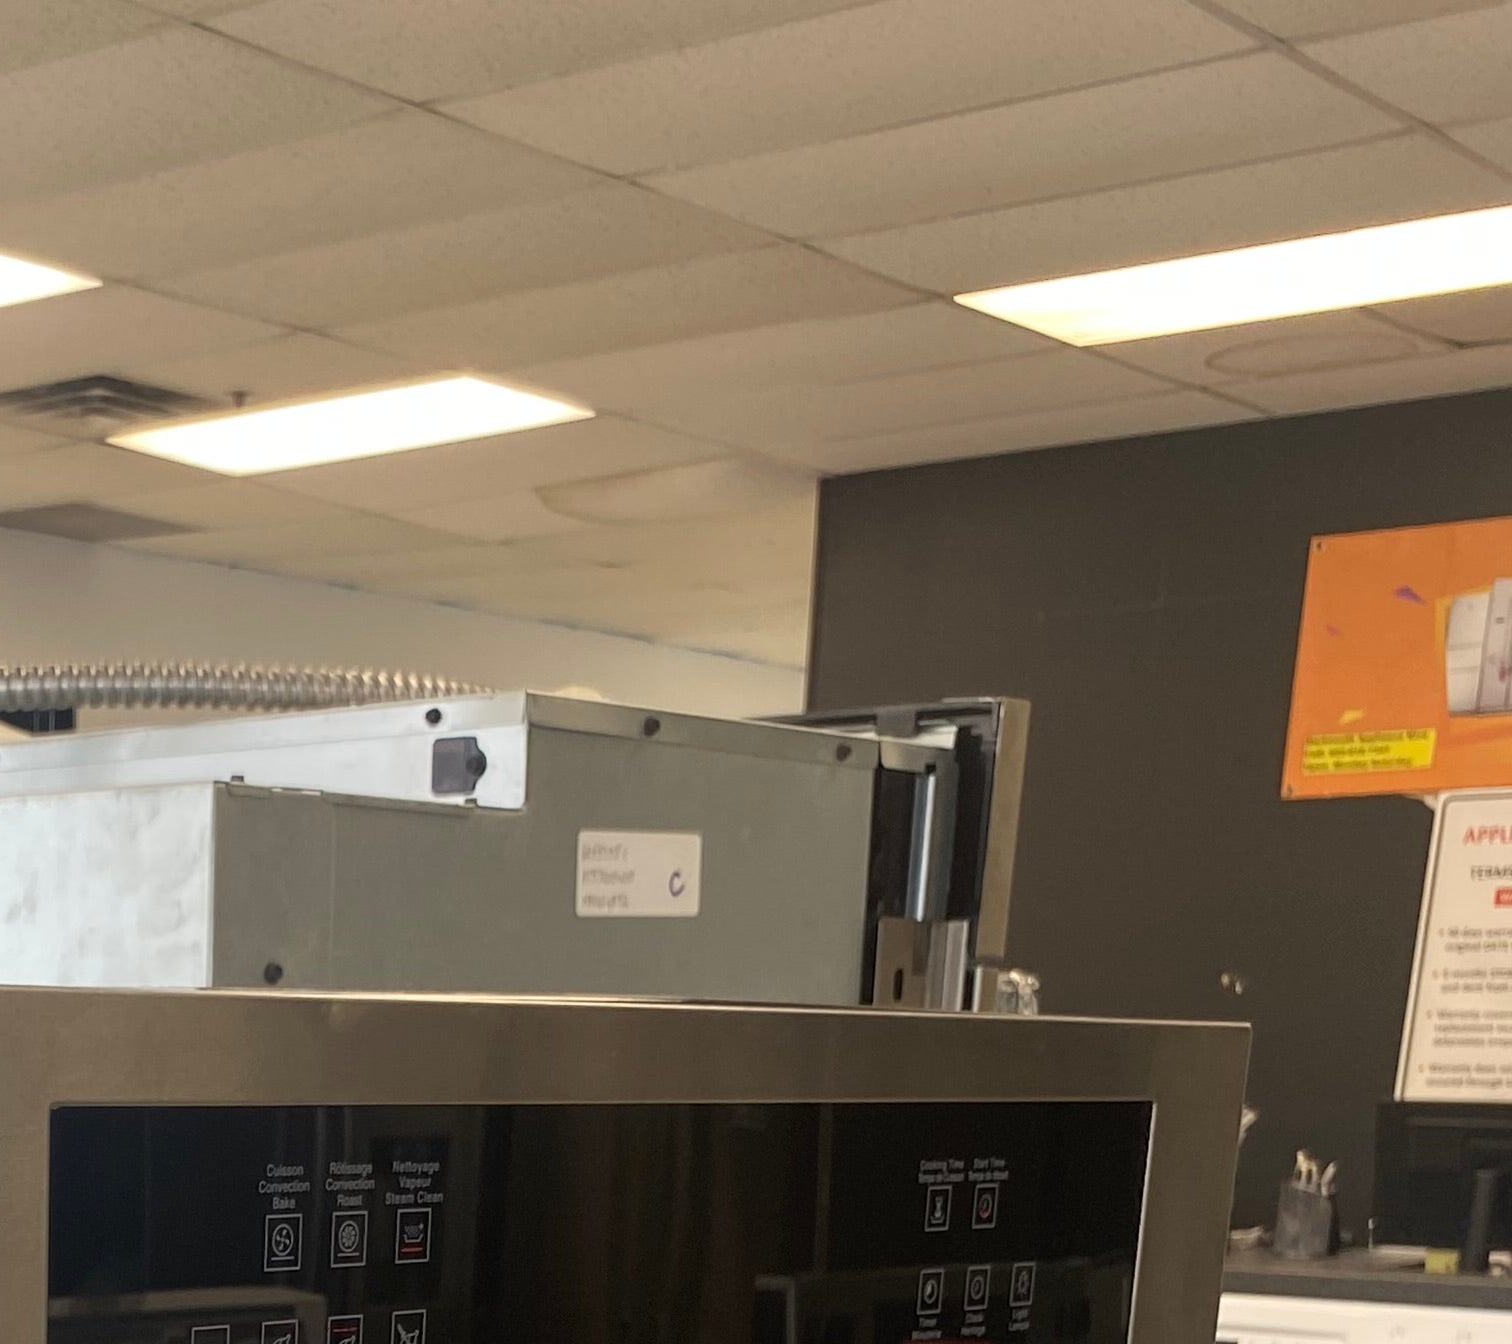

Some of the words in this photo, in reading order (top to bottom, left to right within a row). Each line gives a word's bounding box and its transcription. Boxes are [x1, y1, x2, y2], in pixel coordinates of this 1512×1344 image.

[266, 1164, 303, 1177] Cuisson
[392, 1160, 440, 1175] Nettoyage
[258, 1180, 311, 1193] Convection
[325, 1178, 376, 1191] Convection
[398, 1176, 431, 1190] Vapeur
[272, 1197, 296, 1210] Bake
[385, 1192, 415, 1205] Steam
[416, 1190, 444, 1204] Clean
